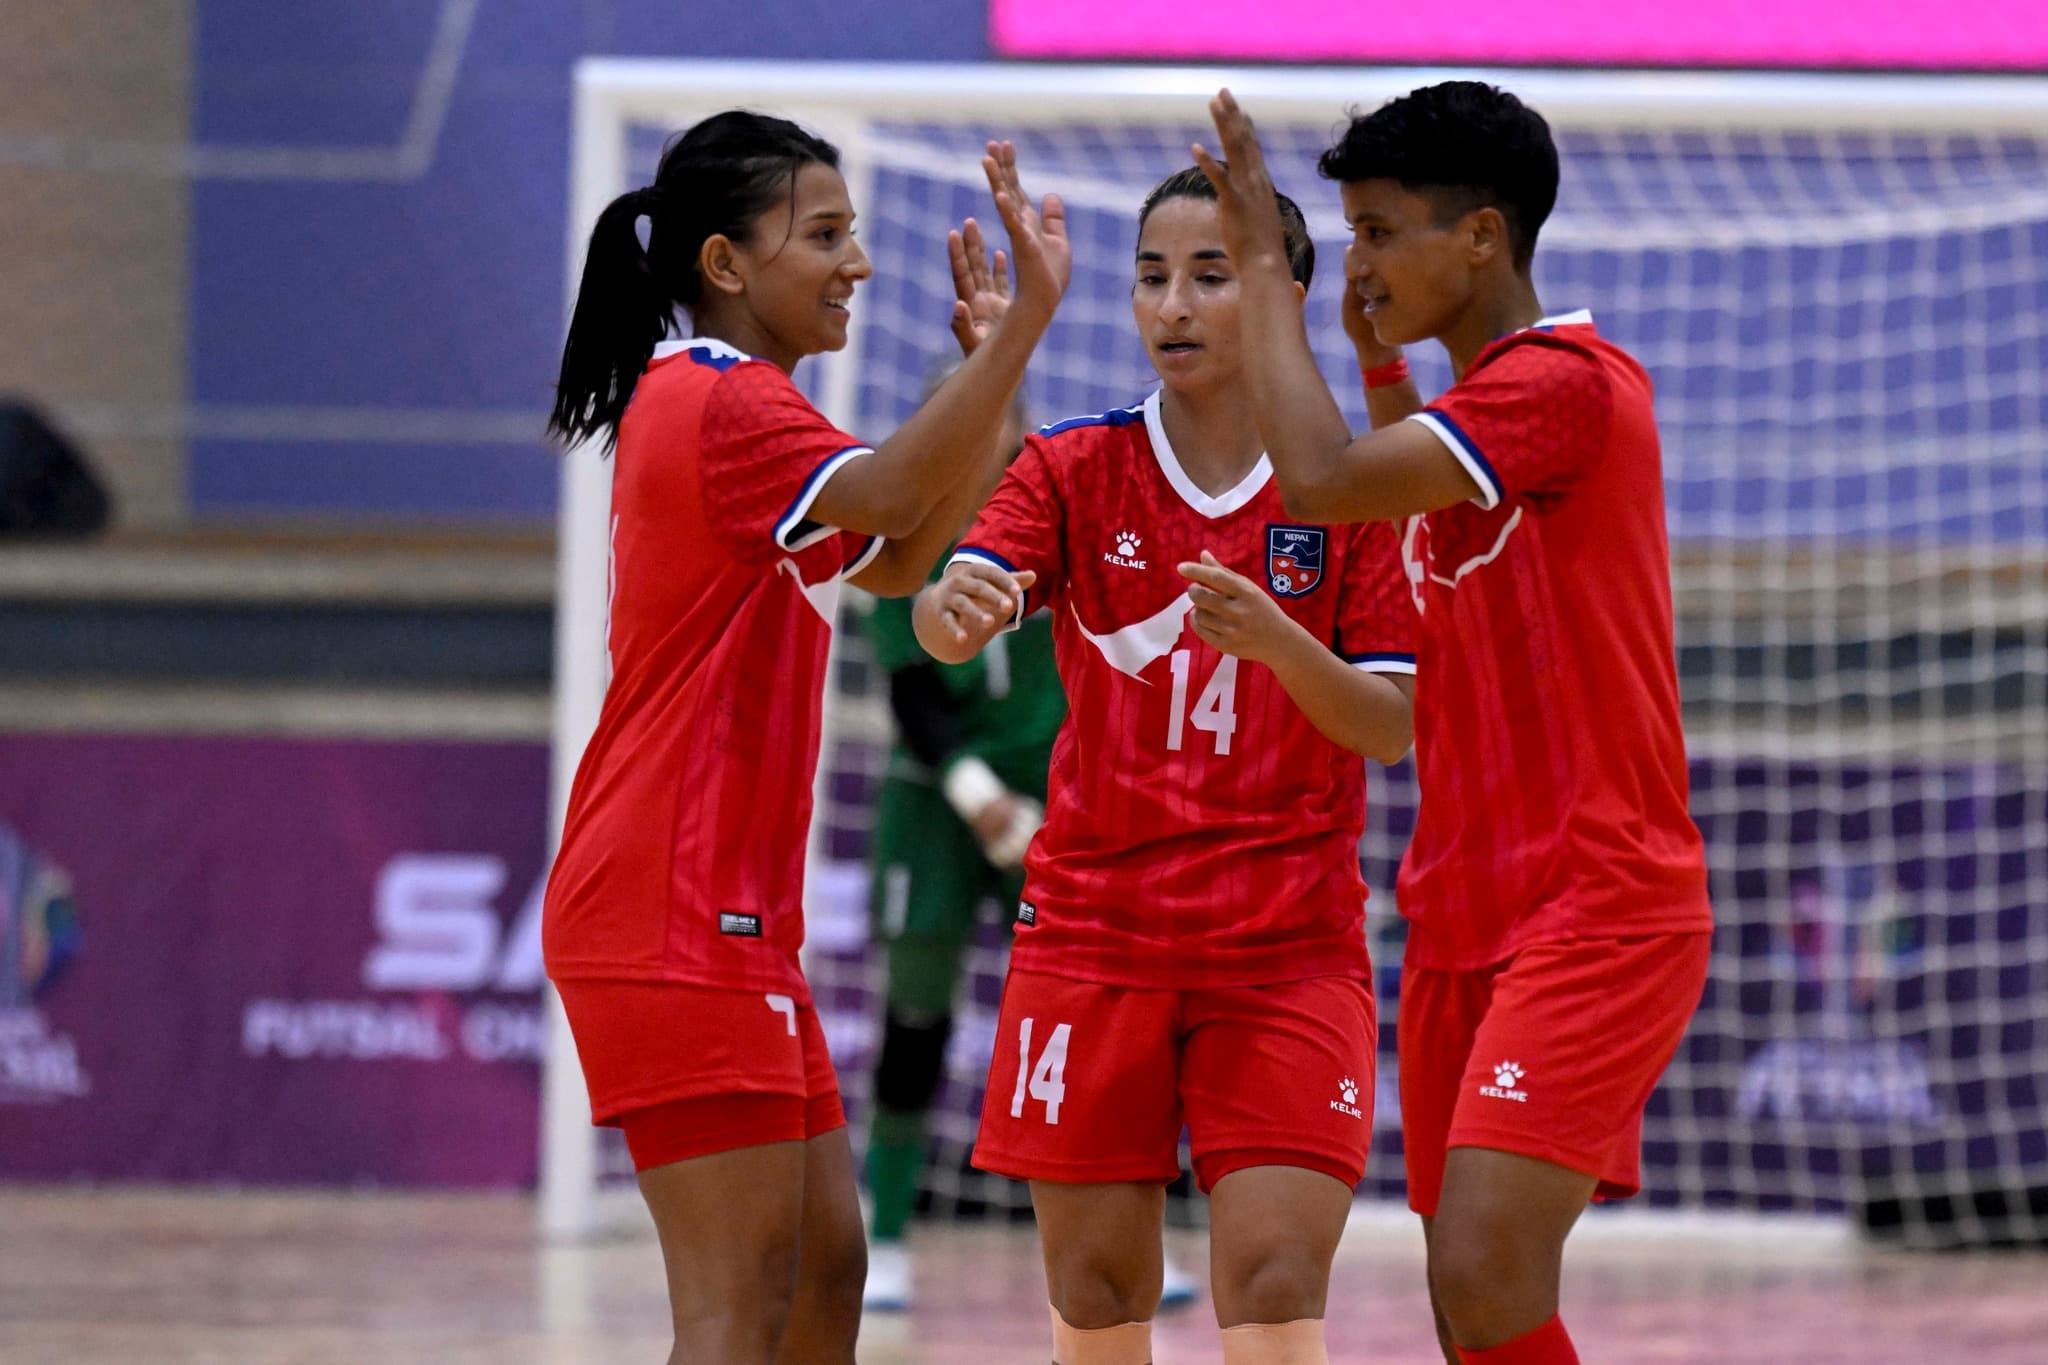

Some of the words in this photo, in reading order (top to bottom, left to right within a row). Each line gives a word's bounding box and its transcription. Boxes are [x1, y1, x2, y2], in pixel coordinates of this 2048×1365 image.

[1284, 532, 1310, 543] NEPAL
[1104, 552, 1147, 570] KELME
[1166, 649, 1239, 756] 14
[1010, 1016, 1073, 1126] 14
[1479, 1085, 1528, 1103] KELME
[1330, 1100, 1362, 1120] KELME
